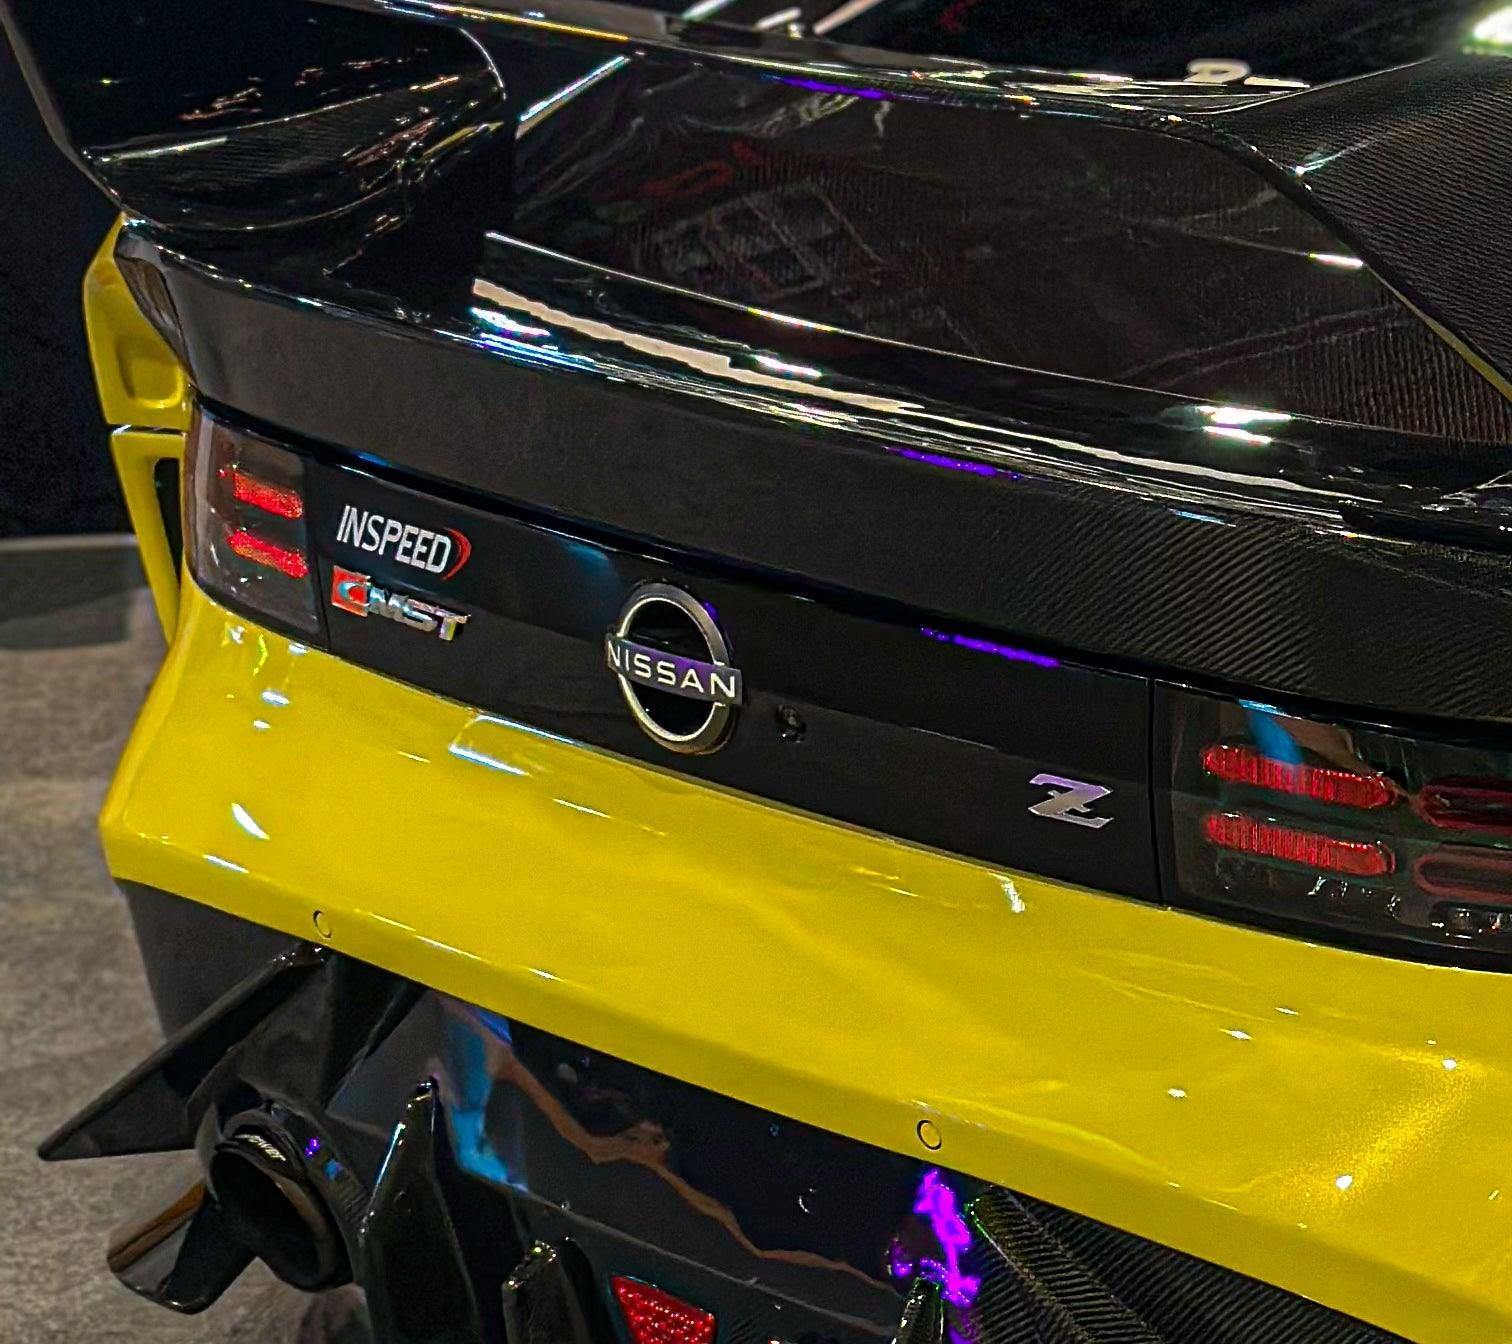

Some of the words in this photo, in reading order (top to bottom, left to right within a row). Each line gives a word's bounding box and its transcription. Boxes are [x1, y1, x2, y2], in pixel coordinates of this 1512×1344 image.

[336, 504, 452, 574] INSPEED
[607, 640, 736, 698] NISSAN
[1027, 773, 1114, 829] Z
